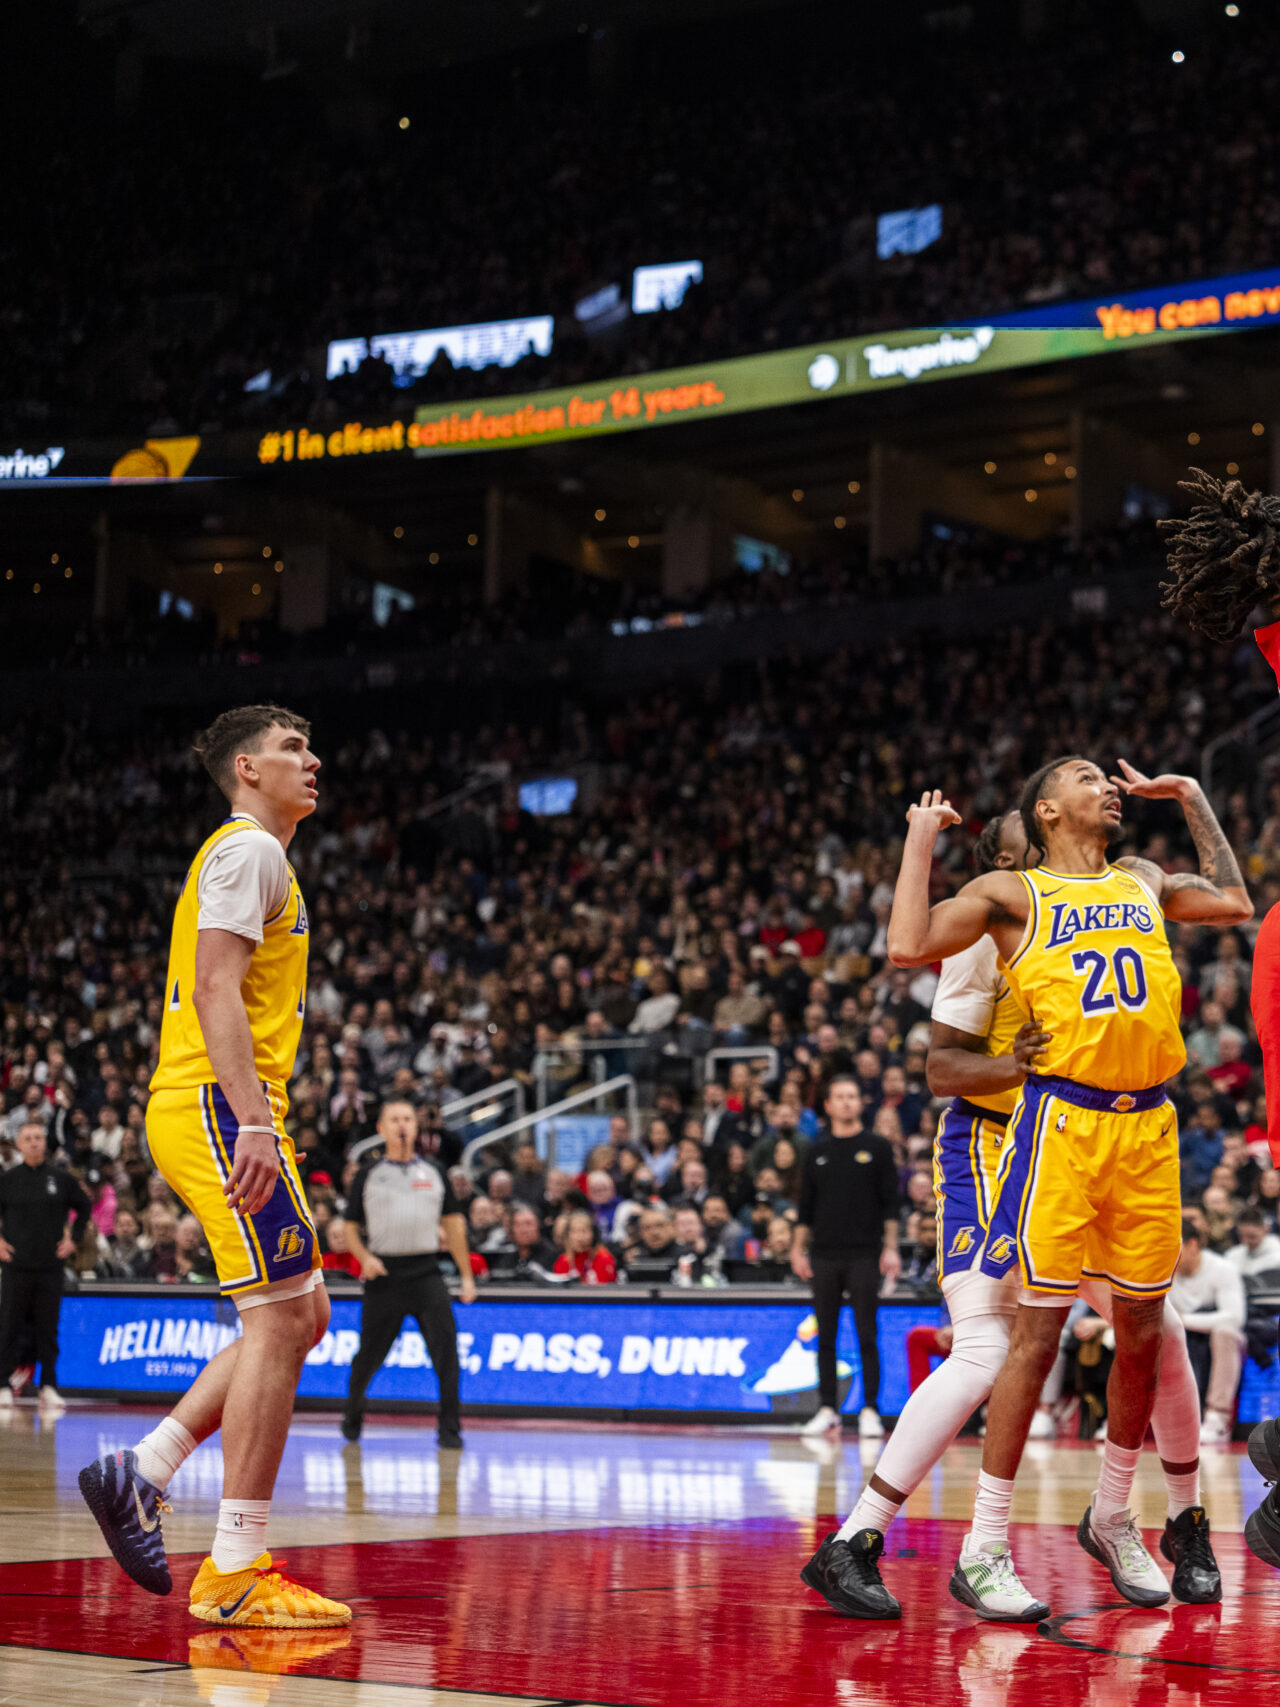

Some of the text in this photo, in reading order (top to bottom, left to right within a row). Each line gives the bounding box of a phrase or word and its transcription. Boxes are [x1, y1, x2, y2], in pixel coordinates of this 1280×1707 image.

[1097, 304, 1156, 340] You
[1158, 296, 1221, 330] can
[864, 331, 984, 379] Tangerine
[258, 381, 724, 464] #1 in client satisfaction for 14 years.
[1043, 902, 1155, 951] LAKERS
[1070, 945, 1149, 1019] 20
[488, 1333, 611, 1379] PASS,
[618, 1335, 749, 1377] DUNK
